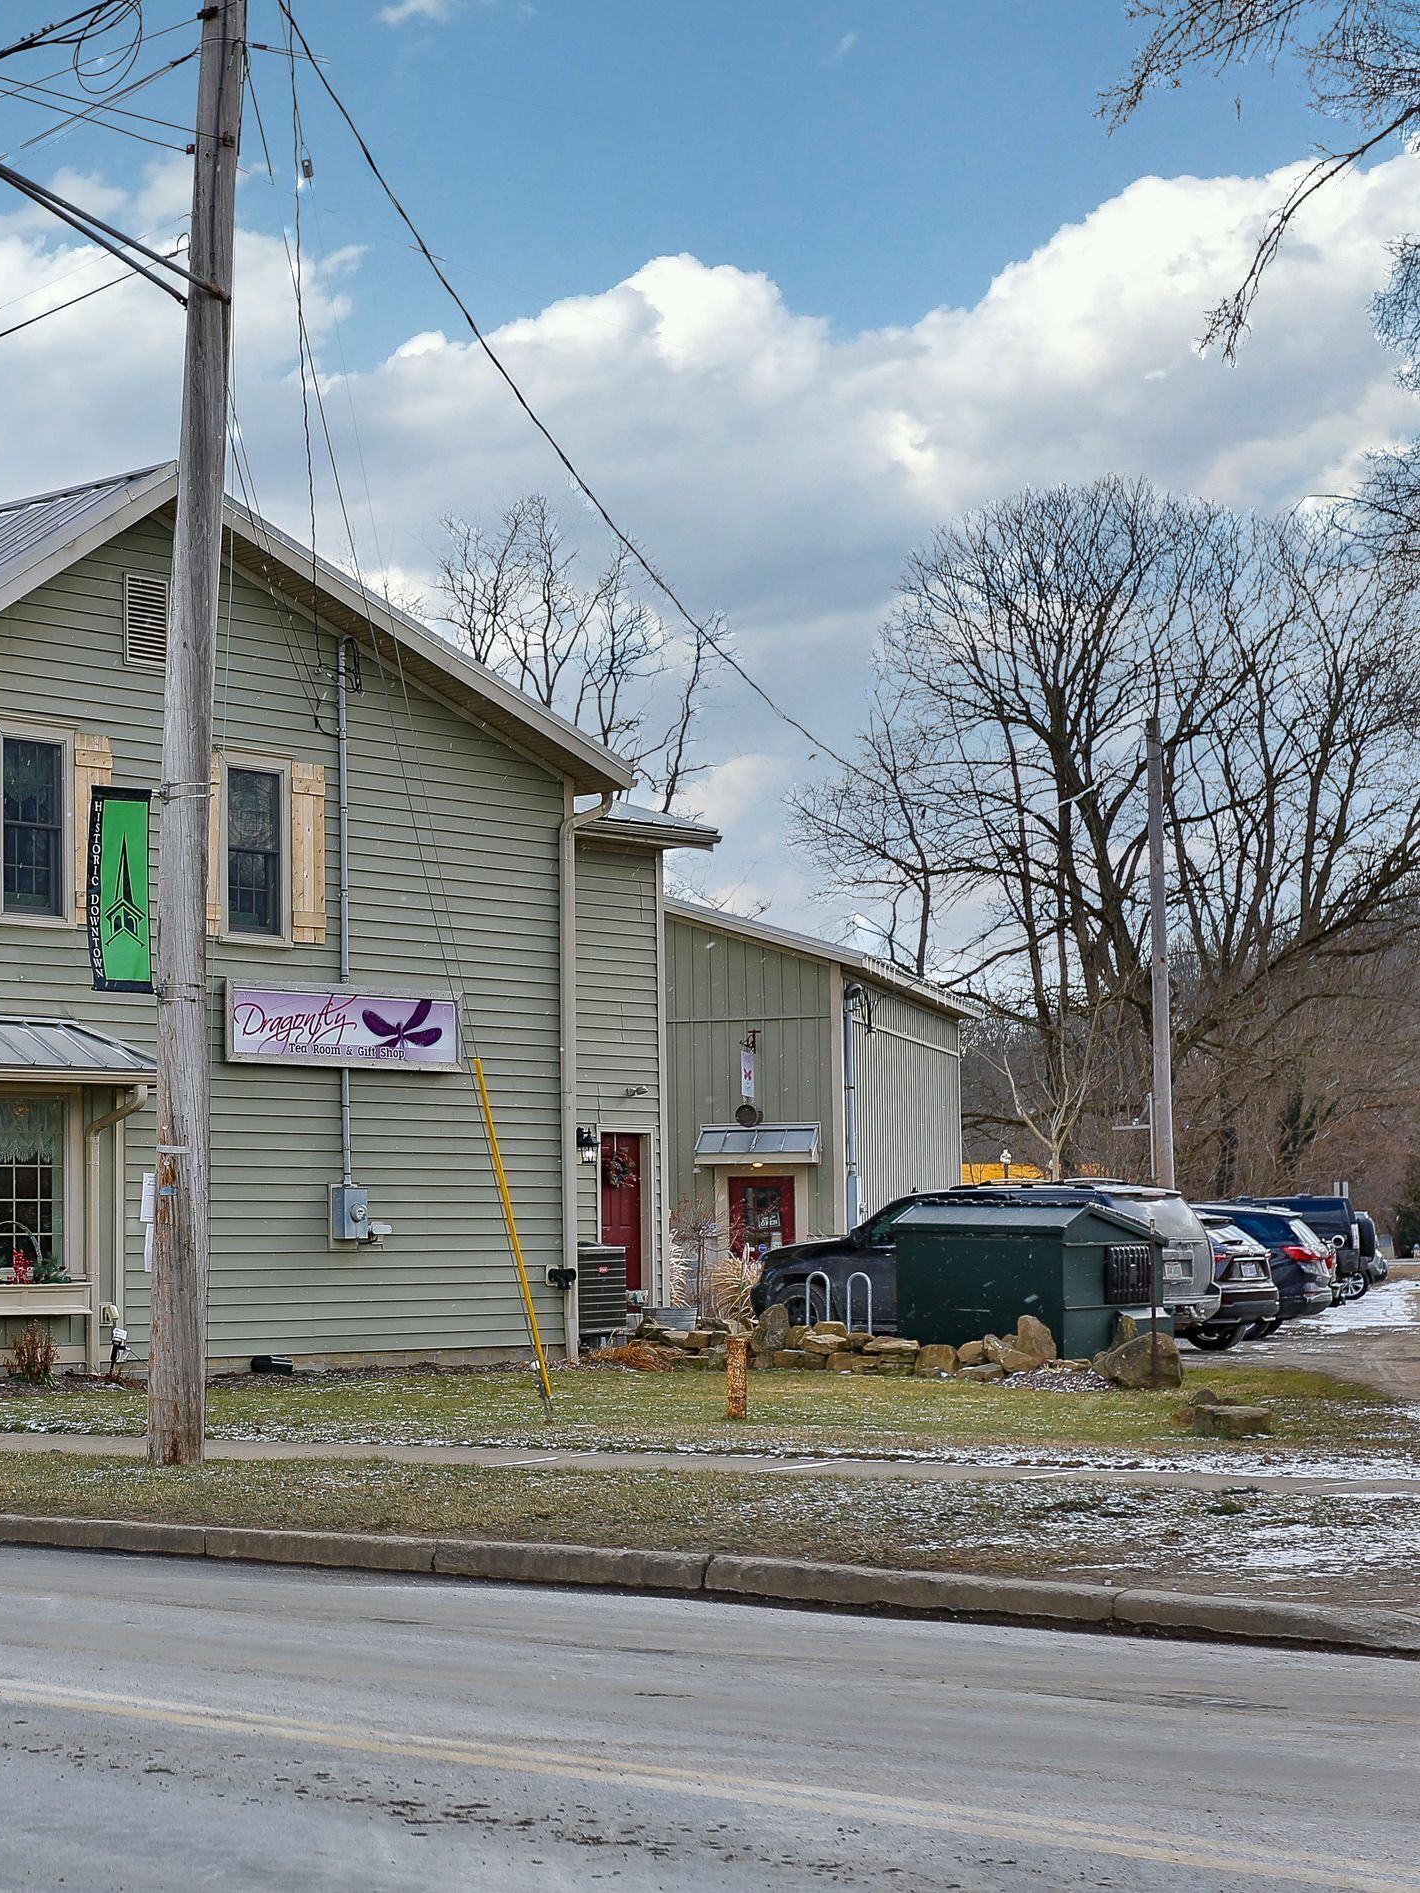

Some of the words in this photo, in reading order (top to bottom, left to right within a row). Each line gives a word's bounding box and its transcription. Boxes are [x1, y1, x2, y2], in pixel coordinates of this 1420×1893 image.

[92, 801, 103, 886] HISTORIC
[90, 894, 104, 978] DOWNTOWN
[233, 993, 358, 1054] Dragonfly
[288, 1043, 308, 1054] Tea
[312, 1045, 341, 1056] Room
[346, 1046, 353, 1056] &
[358, 1046, 376, 1058] Gift
[381, 1048, 406, 1061] Shop
